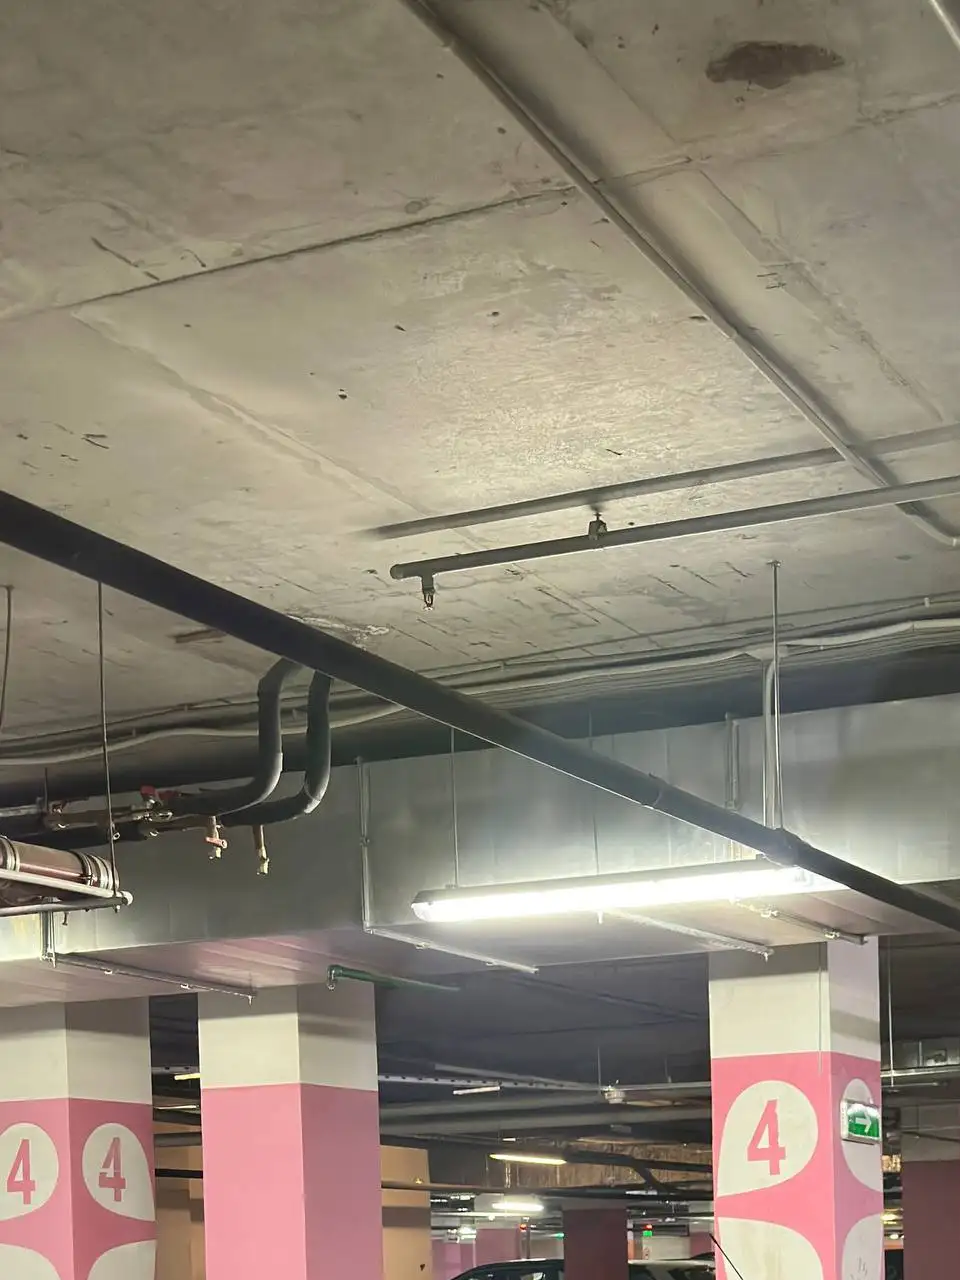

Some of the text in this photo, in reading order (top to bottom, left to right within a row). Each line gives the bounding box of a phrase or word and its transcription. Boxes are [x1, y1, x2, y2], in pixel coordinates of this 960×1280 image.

[99, 1137, 126, 1201] 4
[747, 1099, 786, 1176] 4
[7, 1139, 36, 1204] 4
